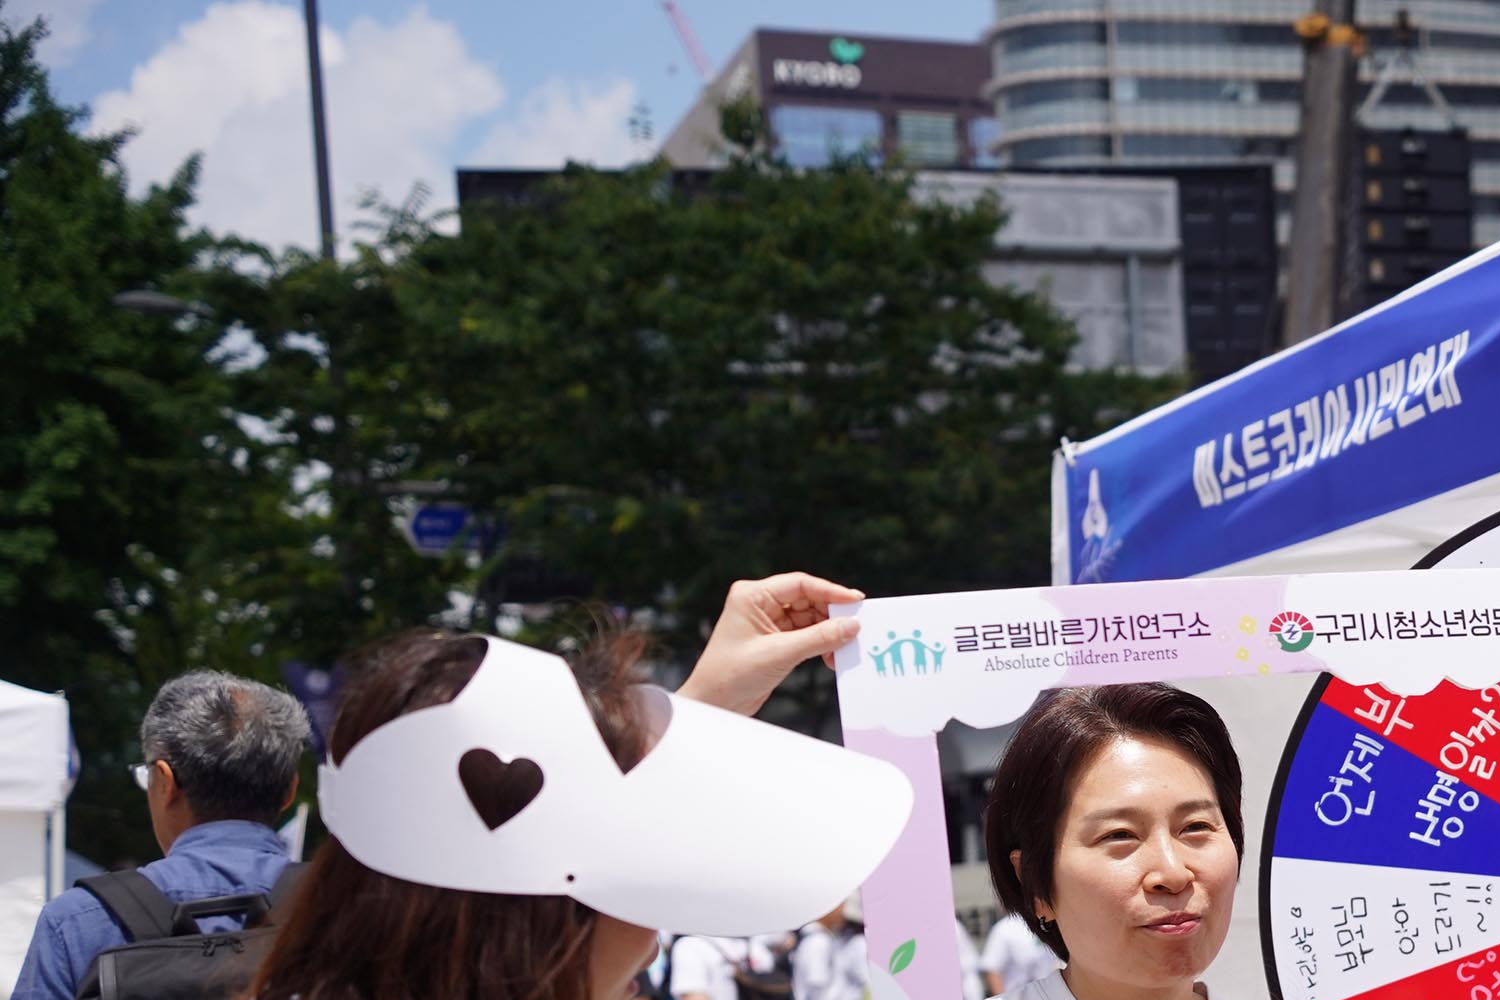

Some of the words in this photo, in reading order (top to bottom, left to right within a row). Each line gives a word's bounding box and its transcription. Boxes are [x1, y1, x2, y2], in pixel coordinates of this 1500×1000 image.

[953, 611, 1212, 653] 글로벌바른가치연구소
[983, 651, 1051, 673] Absolute
[1053, 647, 1120, 668] Children
[1123, 645, 1179, 663] Parents
[1329, 896, 1375, 973] 부모님
[1428, 881, 1463, 955] 드리기
